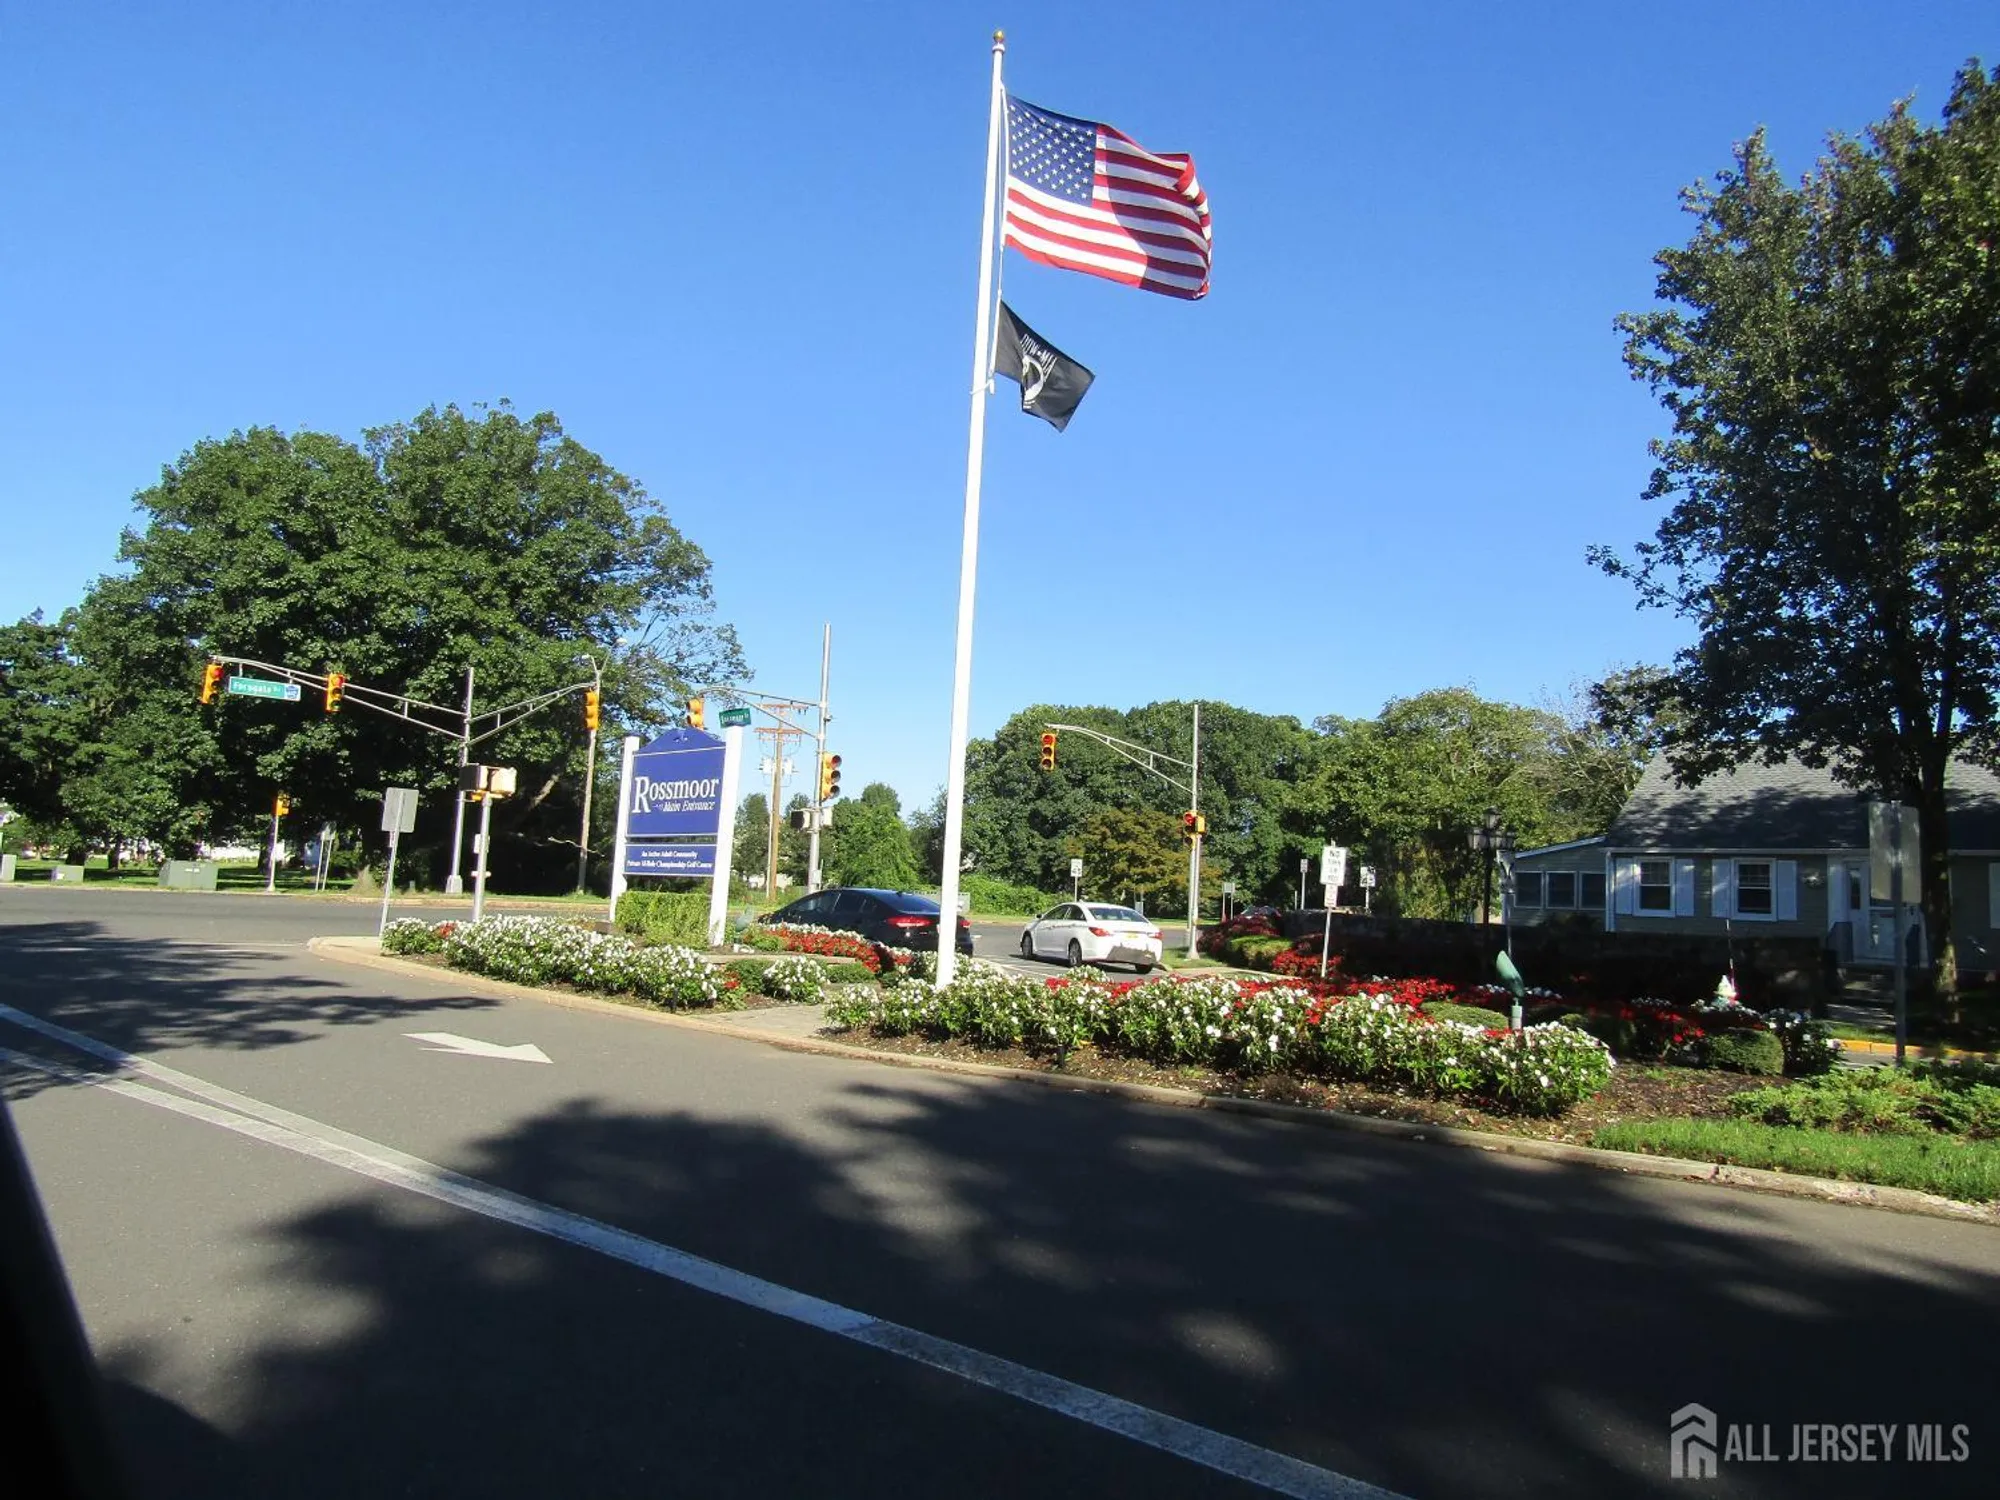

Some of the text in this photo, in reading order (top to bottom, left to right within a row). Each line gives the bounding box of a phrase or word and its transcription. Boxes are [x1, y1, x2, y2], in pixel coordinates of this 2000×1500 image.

[632, 776, 720, 813] Rossmoor
[663, 800, 715, 811] Main Entrance
